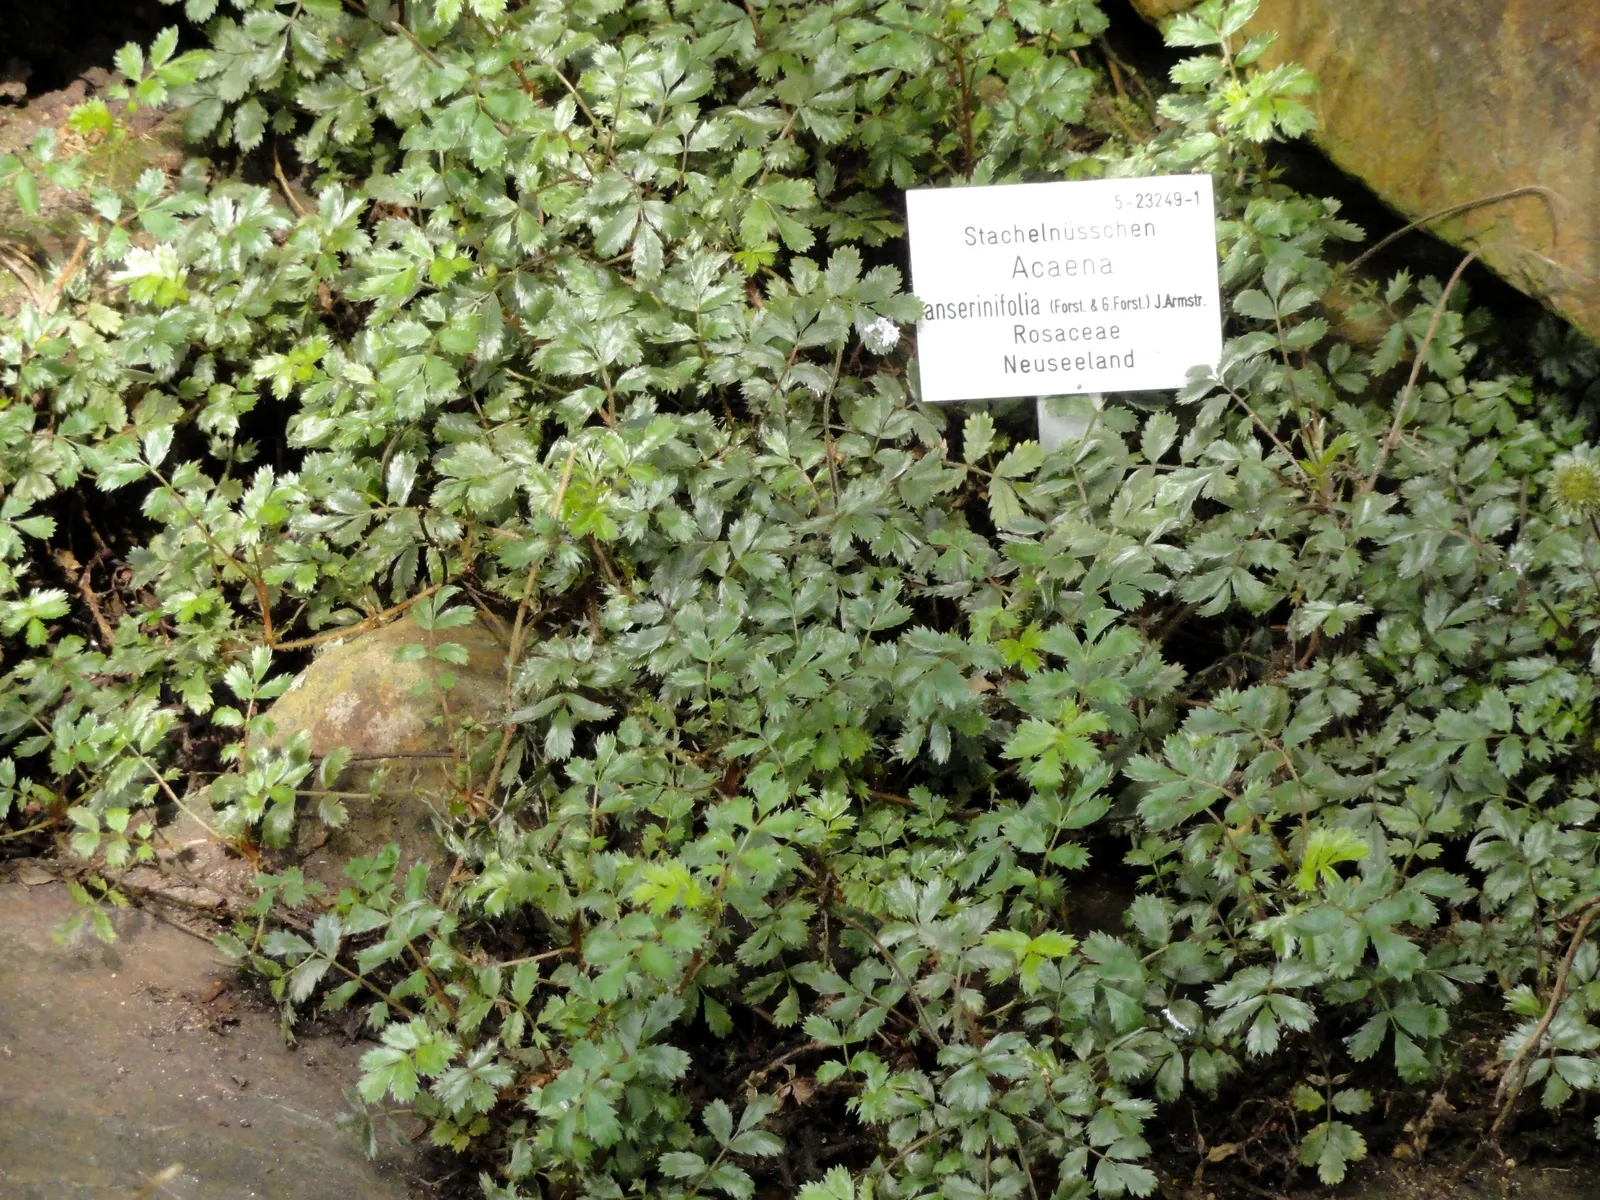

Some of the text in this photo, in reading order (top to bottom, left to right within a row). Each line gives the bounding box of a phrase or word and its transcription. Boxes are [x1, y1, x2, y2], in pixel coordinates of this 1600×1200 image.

[1115, 190, 1200, 209] 5-23249-1
[964, 220, 1156, 246] Stachelnüsschen
[1012, 255, 1114, 279] Acaena
[924, 292, 1040, 321] anserinifolia
[1050, 299, 1086, 314] (Forst.
[1090, 298, 1098, 312] &
[1013, 324, 1120, 344] Rosaceae
[1004, 349, 1135, 374] Neuseeland
